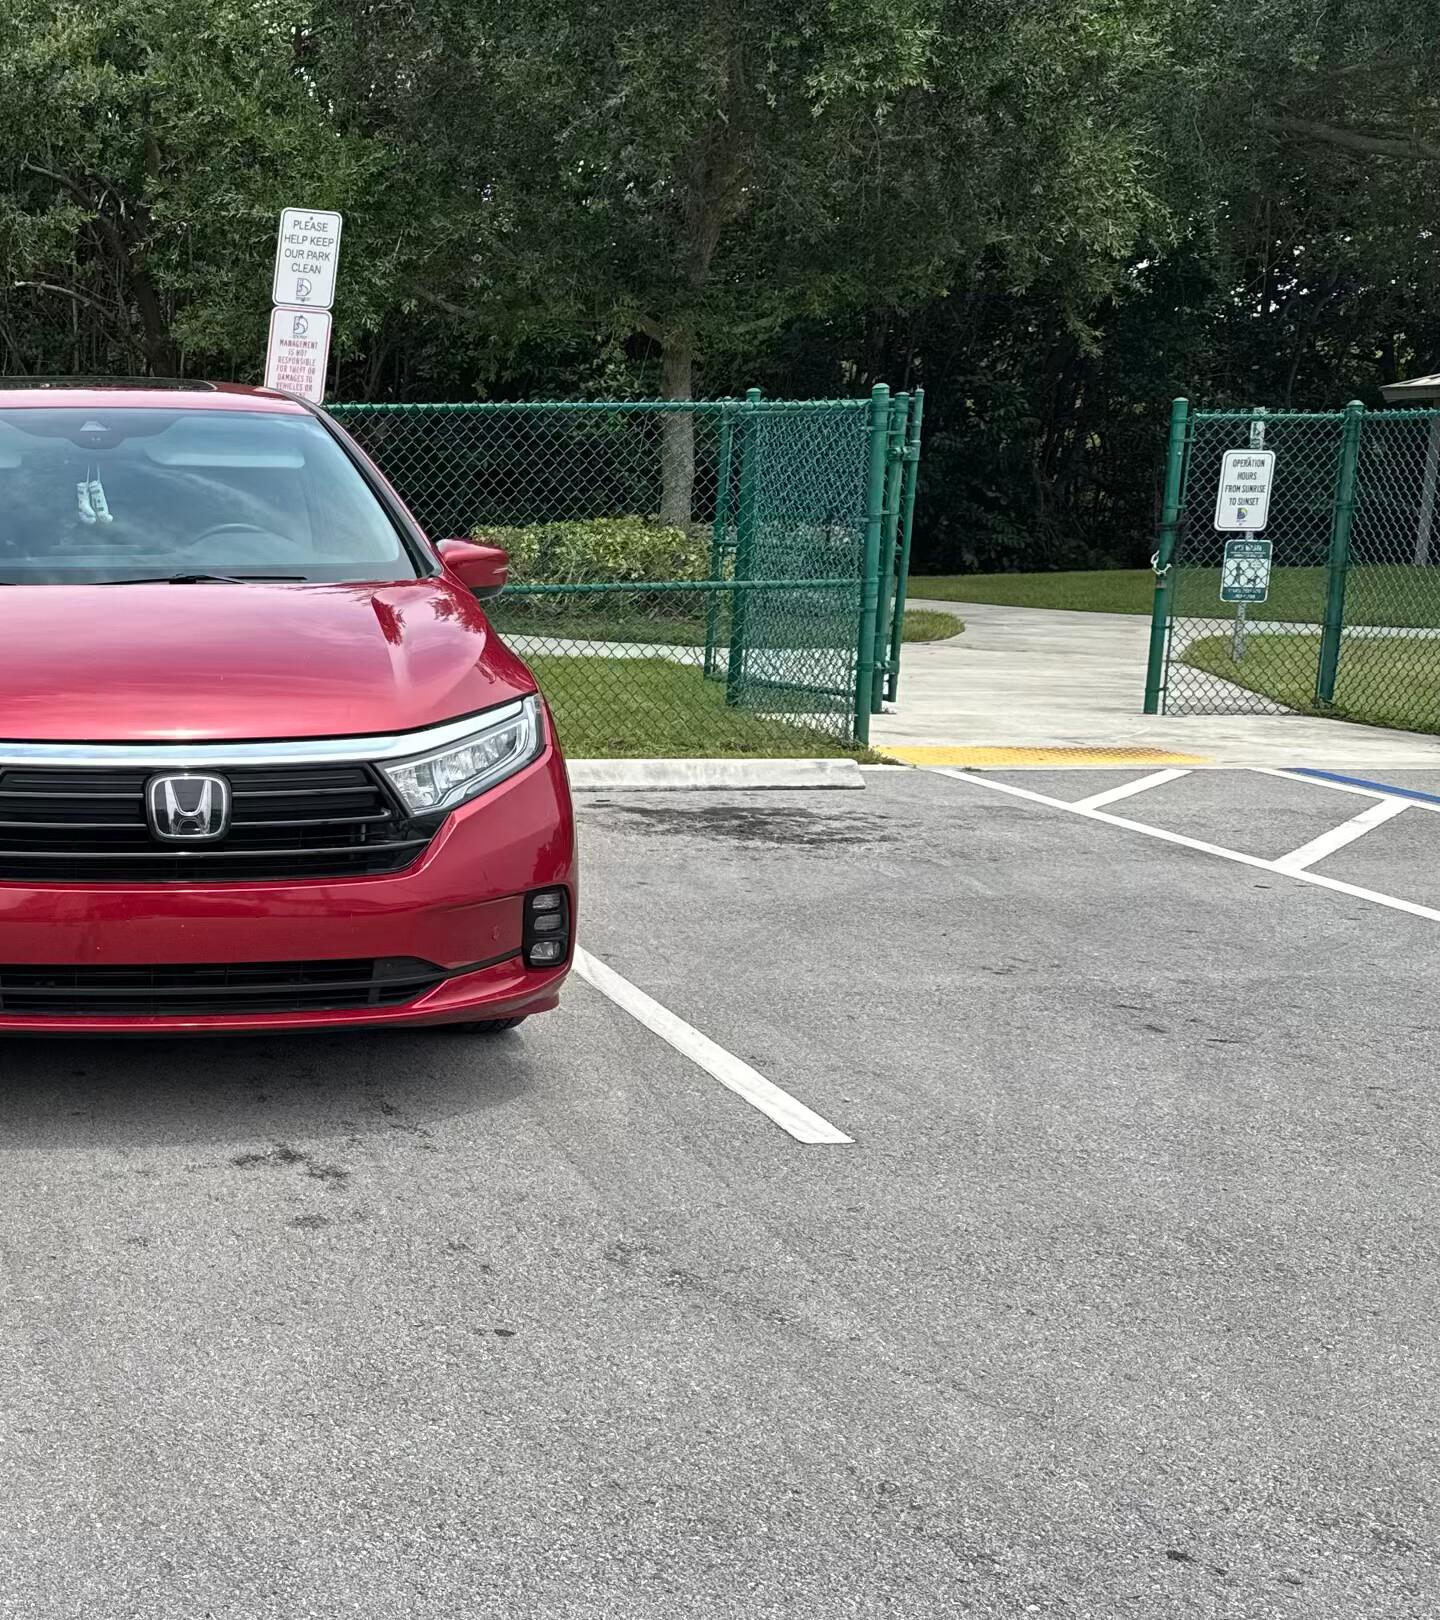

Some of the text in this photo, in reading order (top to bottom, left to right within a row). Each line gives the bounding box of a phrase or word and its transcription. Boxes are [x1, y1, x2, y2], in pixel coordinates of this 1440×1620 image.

[293, 220, 328, 232] PLEASE
[284, 234, 334, 247] HELP KEEP
[284, 248, 330, 261] OUR PARK
[291, 263, 321, 274] CLEAN
[280, 339, 318, 349] MANAGEMENT
[278, 356, 316, 366] RESPONSIBLE
[277, 374, 304, 382] DAMAGES
[305, 384, 312, 392] OR
[1232, 459, 1265, 468] OPERATION
[1237, 472, 1257, 480] HOURS
[1225, 484, 1266, 493] FROM SUNRISE
[1229, 498, 1259, 506] TO SUNSET
